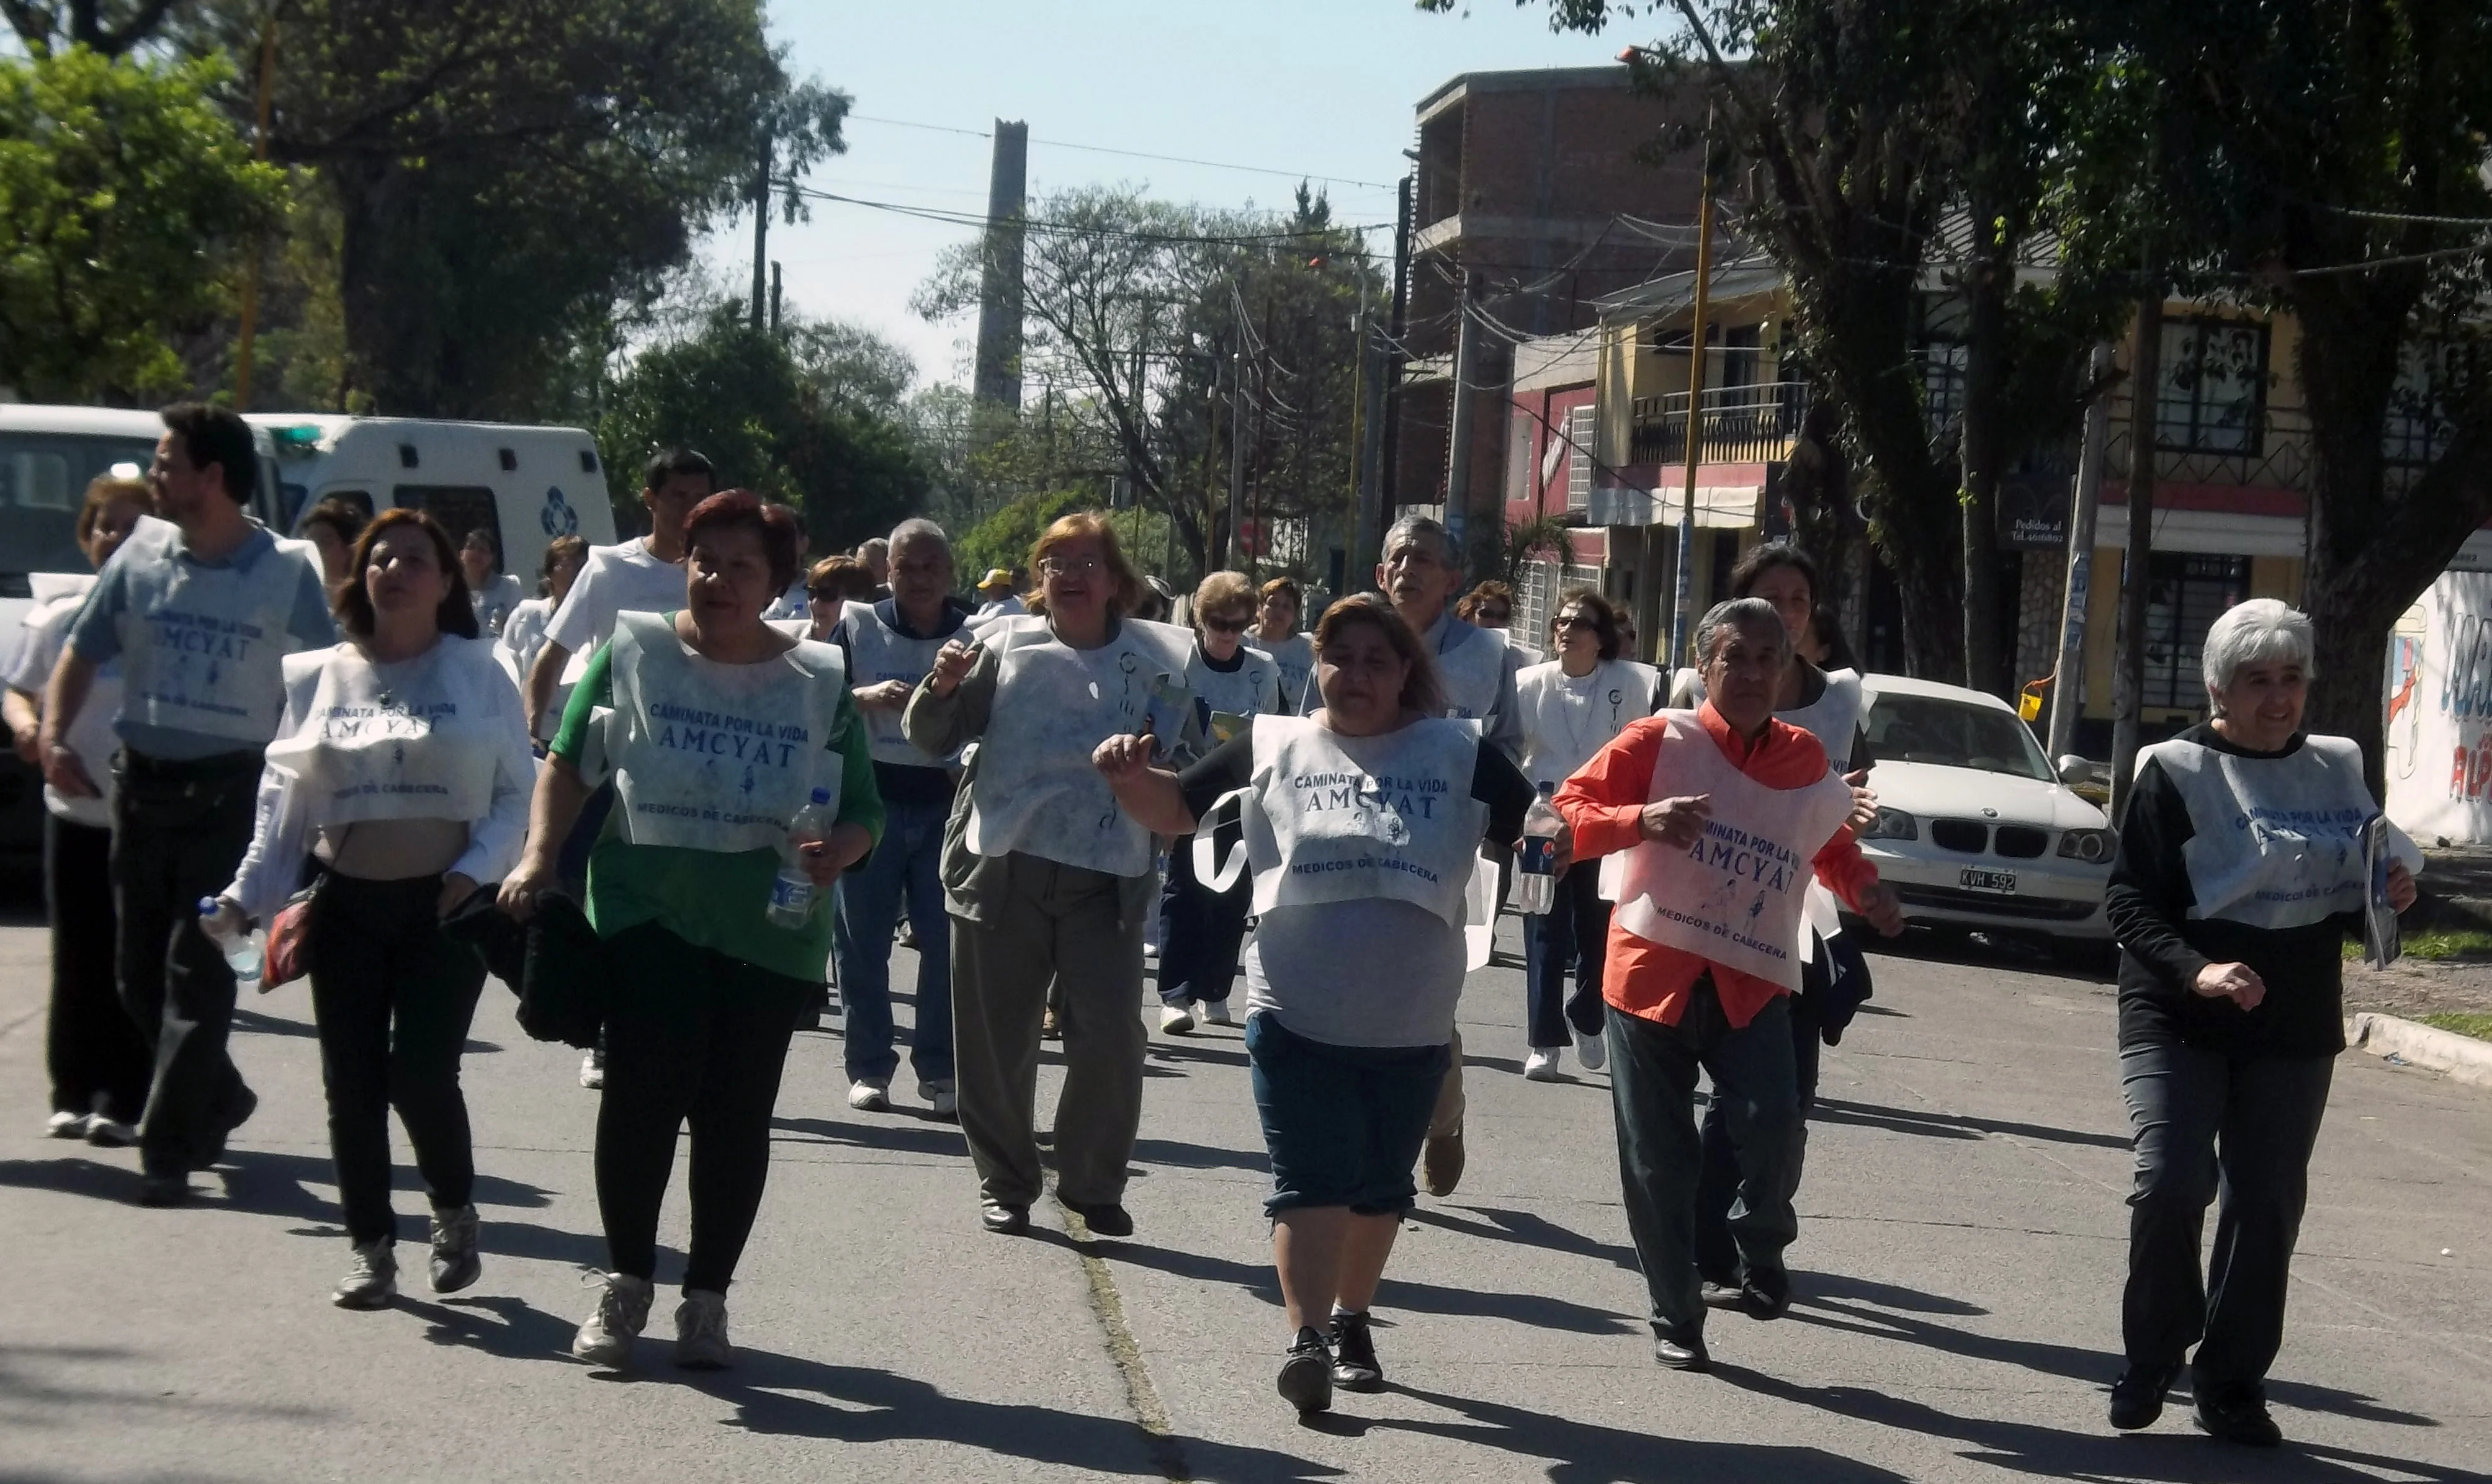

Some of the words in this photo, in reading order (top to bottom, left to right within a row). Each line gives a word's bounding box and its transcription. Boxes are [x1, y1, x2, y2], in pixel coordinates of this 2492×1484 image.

[2015, 519, 2050, 530] Pedidos
[2052, 521, 2062, 531] al
[650, 703, 720, 726] CAMINATA
[725, 716, 753, 733] POR
[756, 723, 774, 737] LA
[778, 725, 809, 743] VIDA
[658, 725, 796, 768] AMCYAT
[1294, 772, 1361, 789] CAMINATA
[1366, 776, 1393, 790] POR
[1397, 777, 1414, 791] LA
[1419, 778, 1448, 793] VIDA
[637, 803, 698, 818] MEDICOS
[702, 810, 719, 821] DE
[724, 813, 789, 833] CABECERA
[1305, 787, 1437, 820] AMCYAT
[2316, 811, 2332, 825] LA
[1706, 820, 1748, 847] MINATA
[1750, 836, 1775, 856] POR
[1777, 846, 1790, 865] LA
[1292, 859, 1353, 875] MEDICOS
[1358, 857, 1376, 869] DE
[1378, 858, 1438, 884] CABECERA
[1961, 869, 1986, 887] KVH
[1991, 874, 2015, 890] 592
[1656, 906, 1710, 931] MEDICOS
[1713, 924, 1728, 939] DE
[1732, 932, 1787, 961] CABECERA
